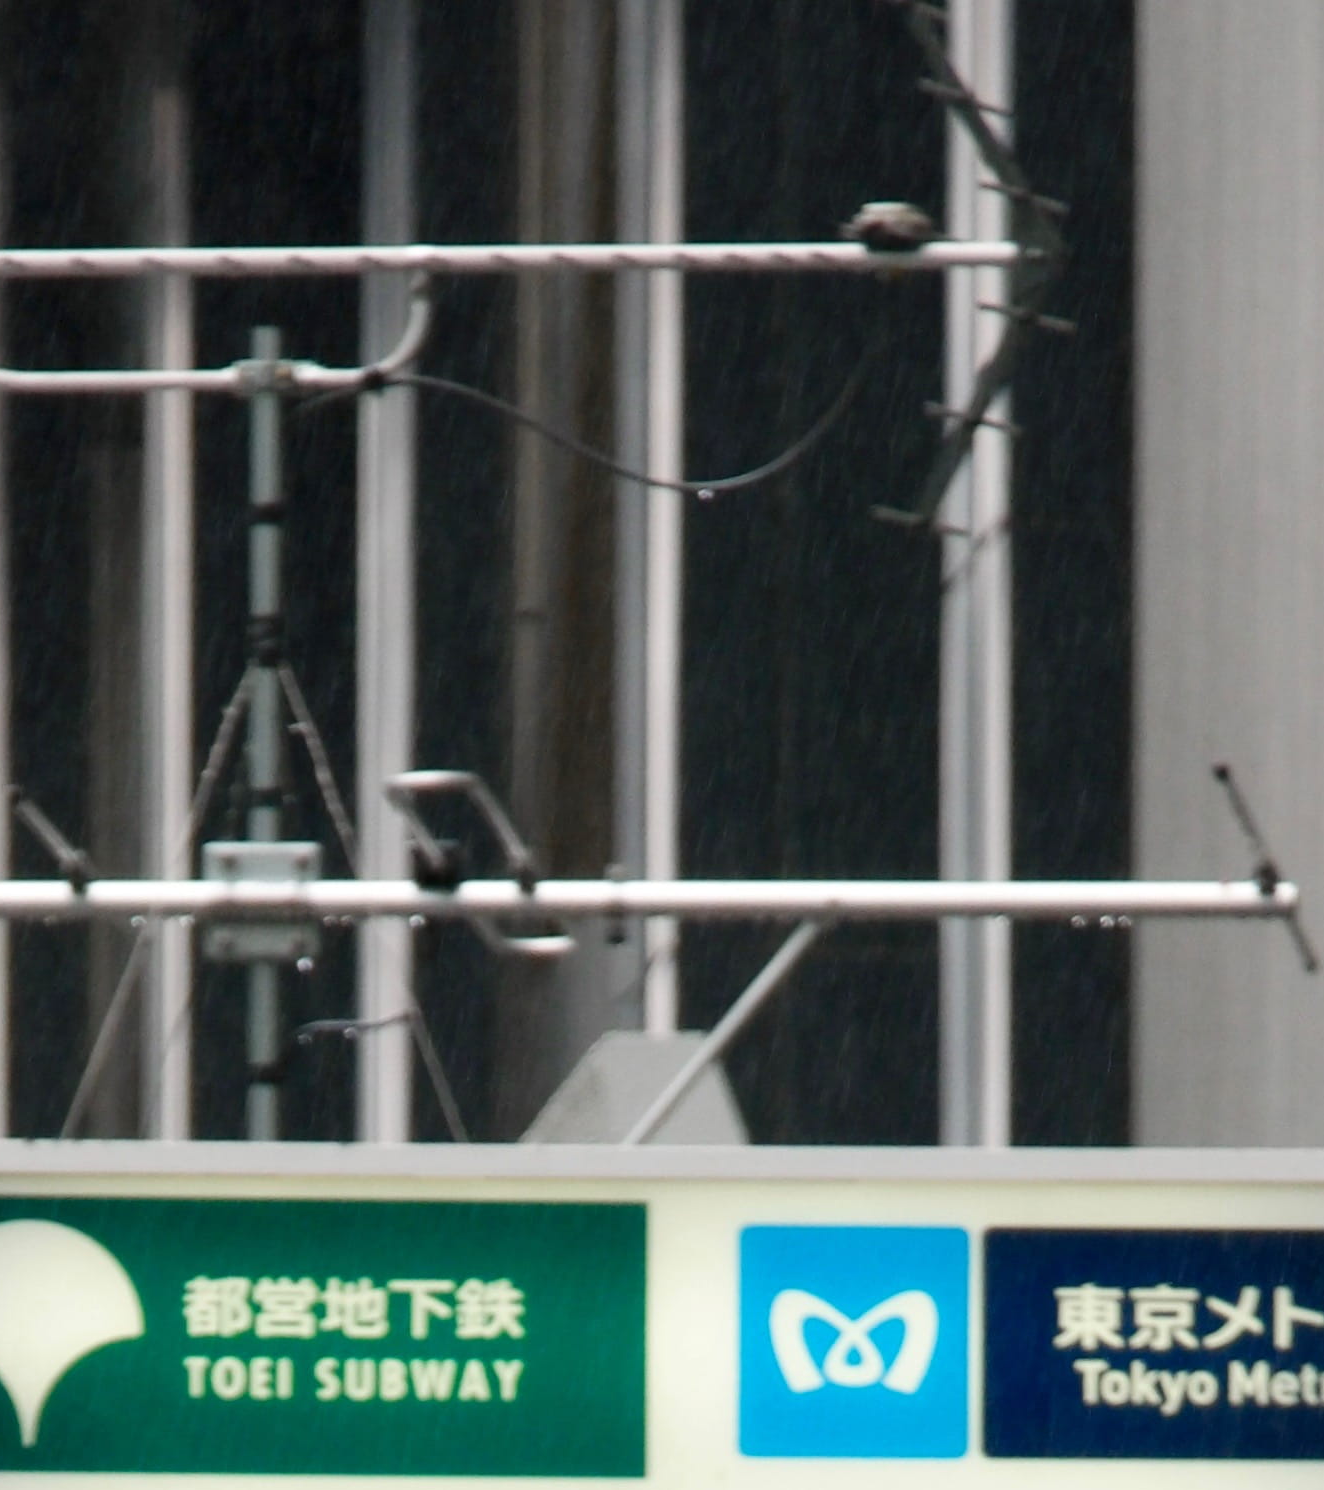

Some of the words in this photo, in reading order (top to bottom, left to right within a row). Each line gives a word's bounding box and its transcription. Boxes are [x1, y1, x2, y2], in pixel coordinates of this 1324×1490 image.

[182, 1275, 525, 1340] 都営地下鉄
[183, 1355, 293, 1401] TOEI
[314, 1357, 524, 1402] SUBWAY
[1073, 1359, 1218, 1415] Tokyo
